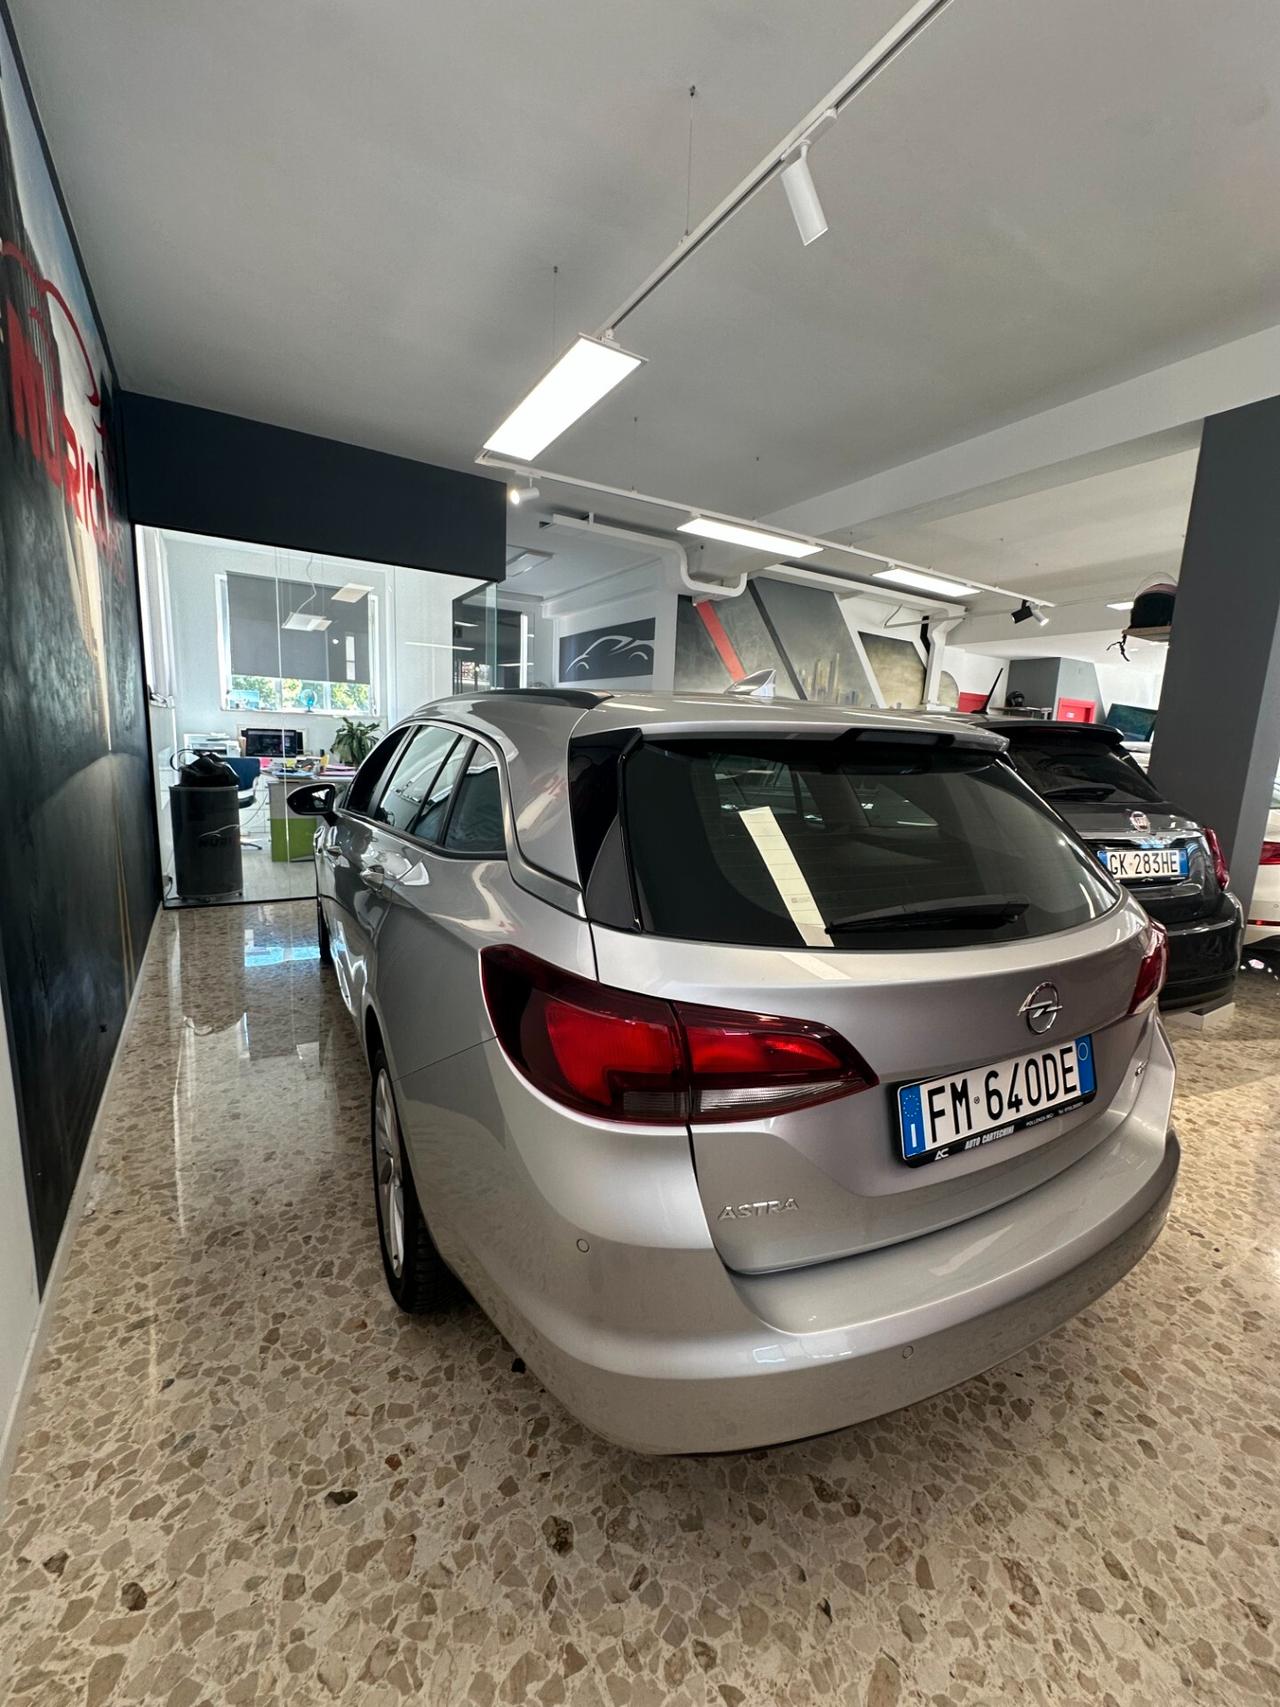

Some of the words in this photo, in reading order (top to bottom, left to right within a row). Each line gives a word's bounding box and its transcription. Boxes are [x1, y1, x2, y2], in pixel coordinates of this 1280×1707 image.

[1109, 853, 1128, 875] GK
[1134, 852, 1178, 875] 283HE
[927, 1078, 973, 1143] FM
[984, 1046, 1078, 1121] 640DE
[964, 1137, 981, 1151] AUTO
[717, 1198, 800, 1221] ASTRA
